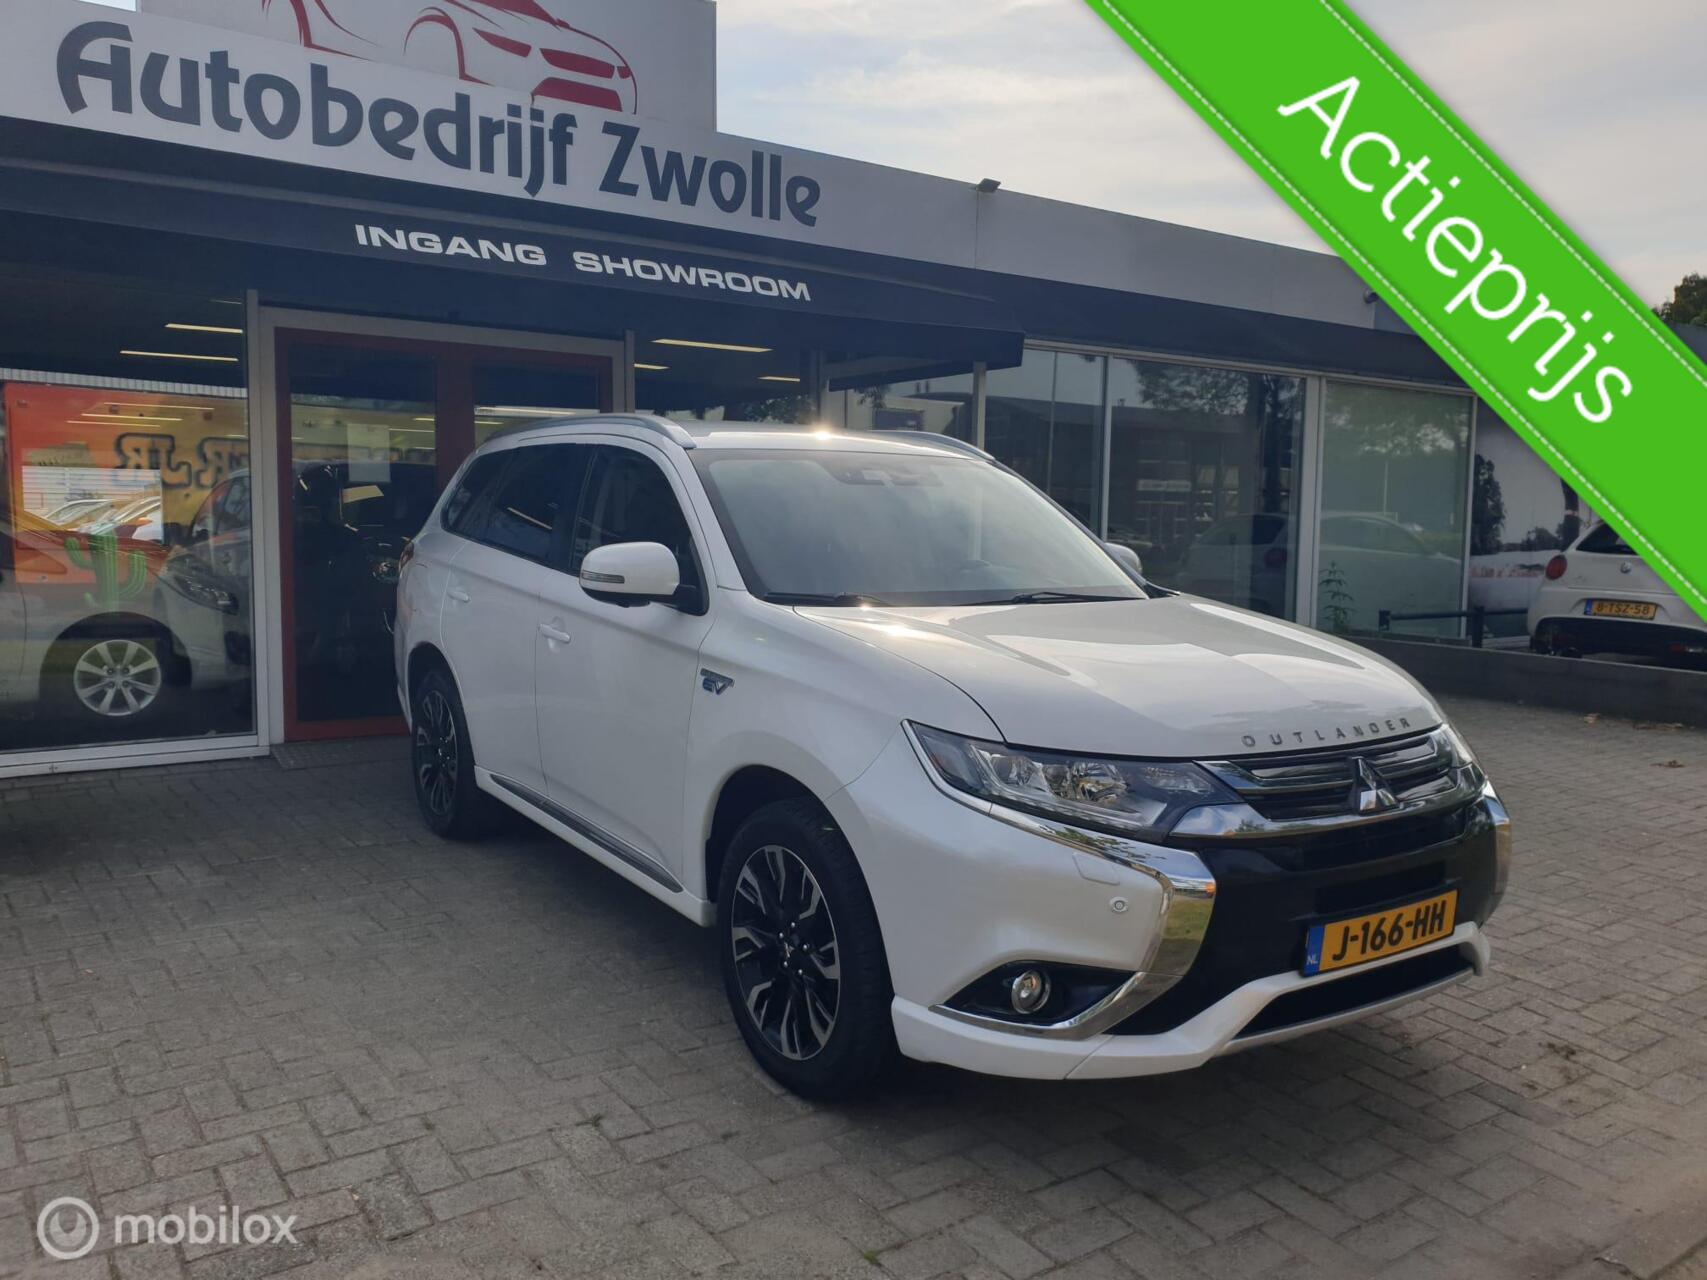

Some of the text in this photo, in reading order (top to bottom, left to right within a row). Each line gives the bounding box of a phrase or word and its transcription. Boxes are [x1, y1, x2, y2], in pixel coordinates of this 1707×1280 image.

[56, 21, 821, 228] Autobedrijf Zwolle
[354, 224, 812, 302] INGANG SHOWROOM
[1242, 717, 1411, 748] OUTLANDER
[1332, 900, 1447, 962] J-166-HH
